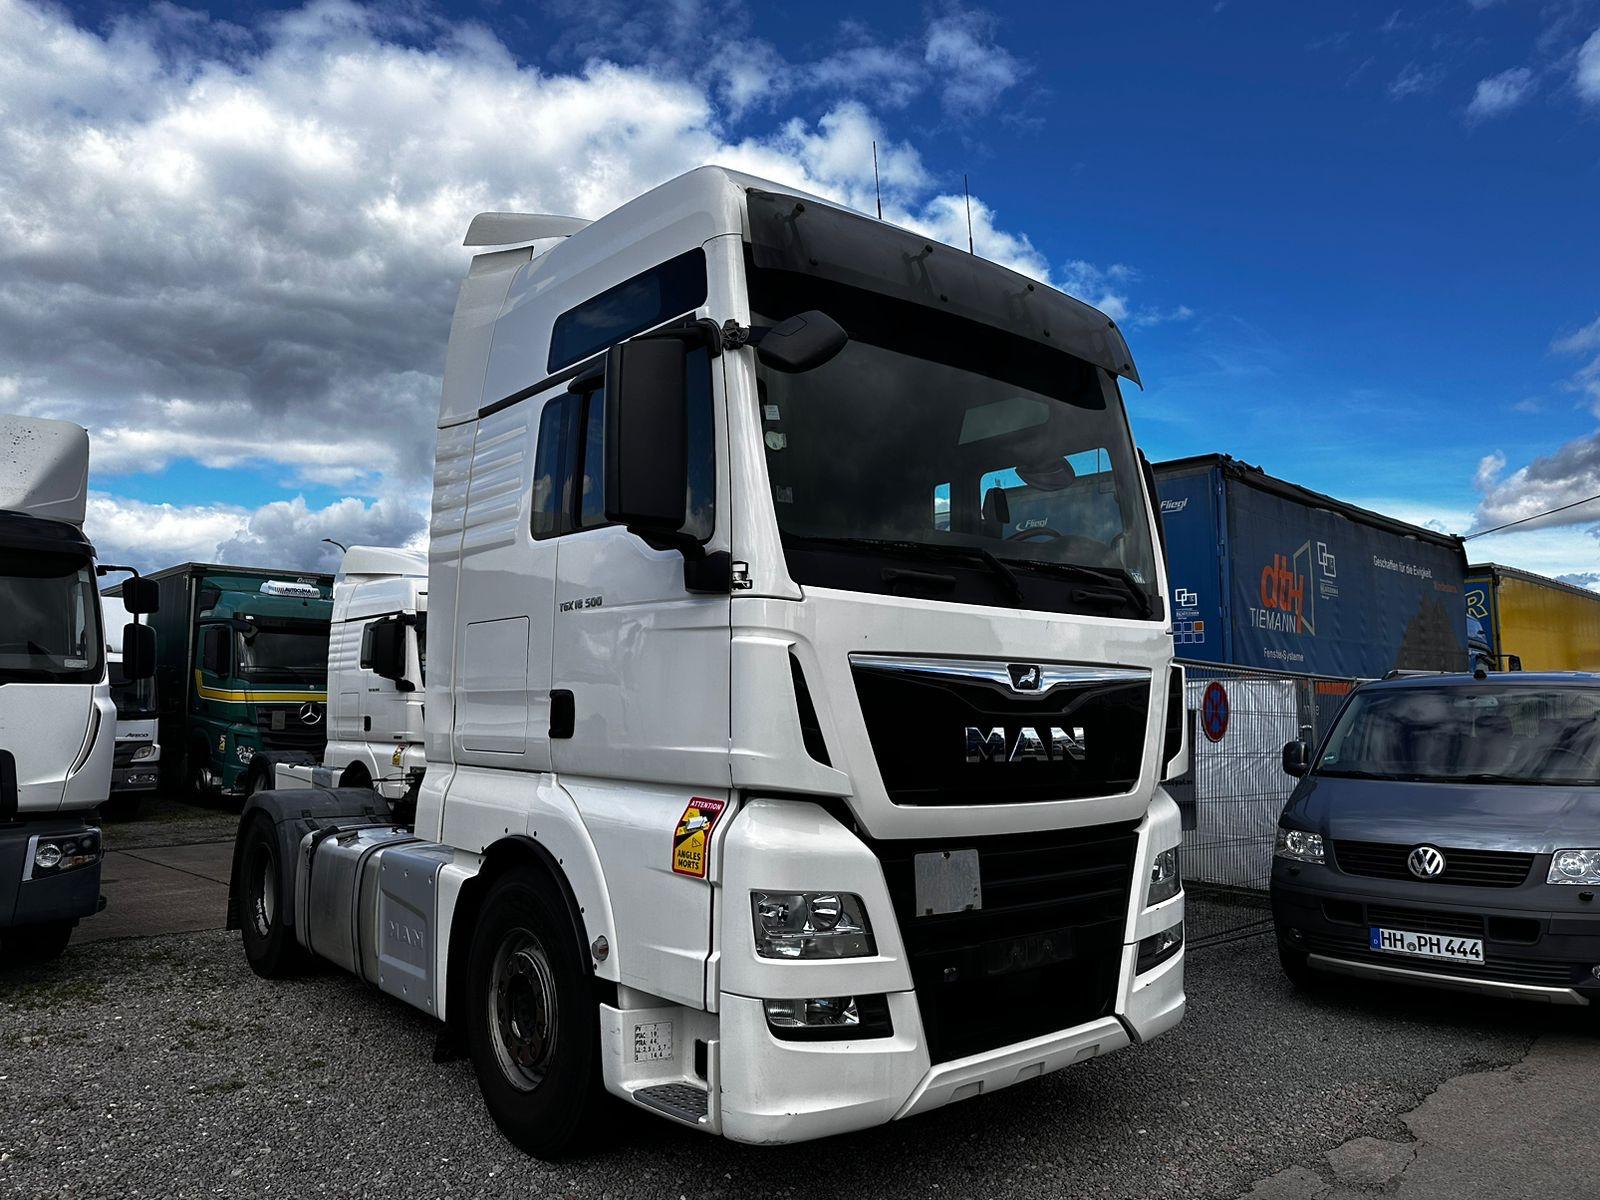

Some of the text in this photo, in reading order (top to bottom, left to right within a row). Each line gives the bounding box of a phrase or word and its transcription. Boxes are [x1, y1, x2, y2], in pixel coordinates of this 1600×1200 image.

[1160, 497, 1189, 511] Fliegl
[1249, 607, 1296, 634] TIEMANN
[964, 726, 1087, 763] MAN
[691, 800, 723, 811] ATTENTION
[677, 849, 701, 861] ANGLES
[677, 859, 700, 870] MORTS
[1381, 930, 1405, 950] HH
[1416, 935, 1442, 955] PH
[1444, 939, 1481, 959] 444
